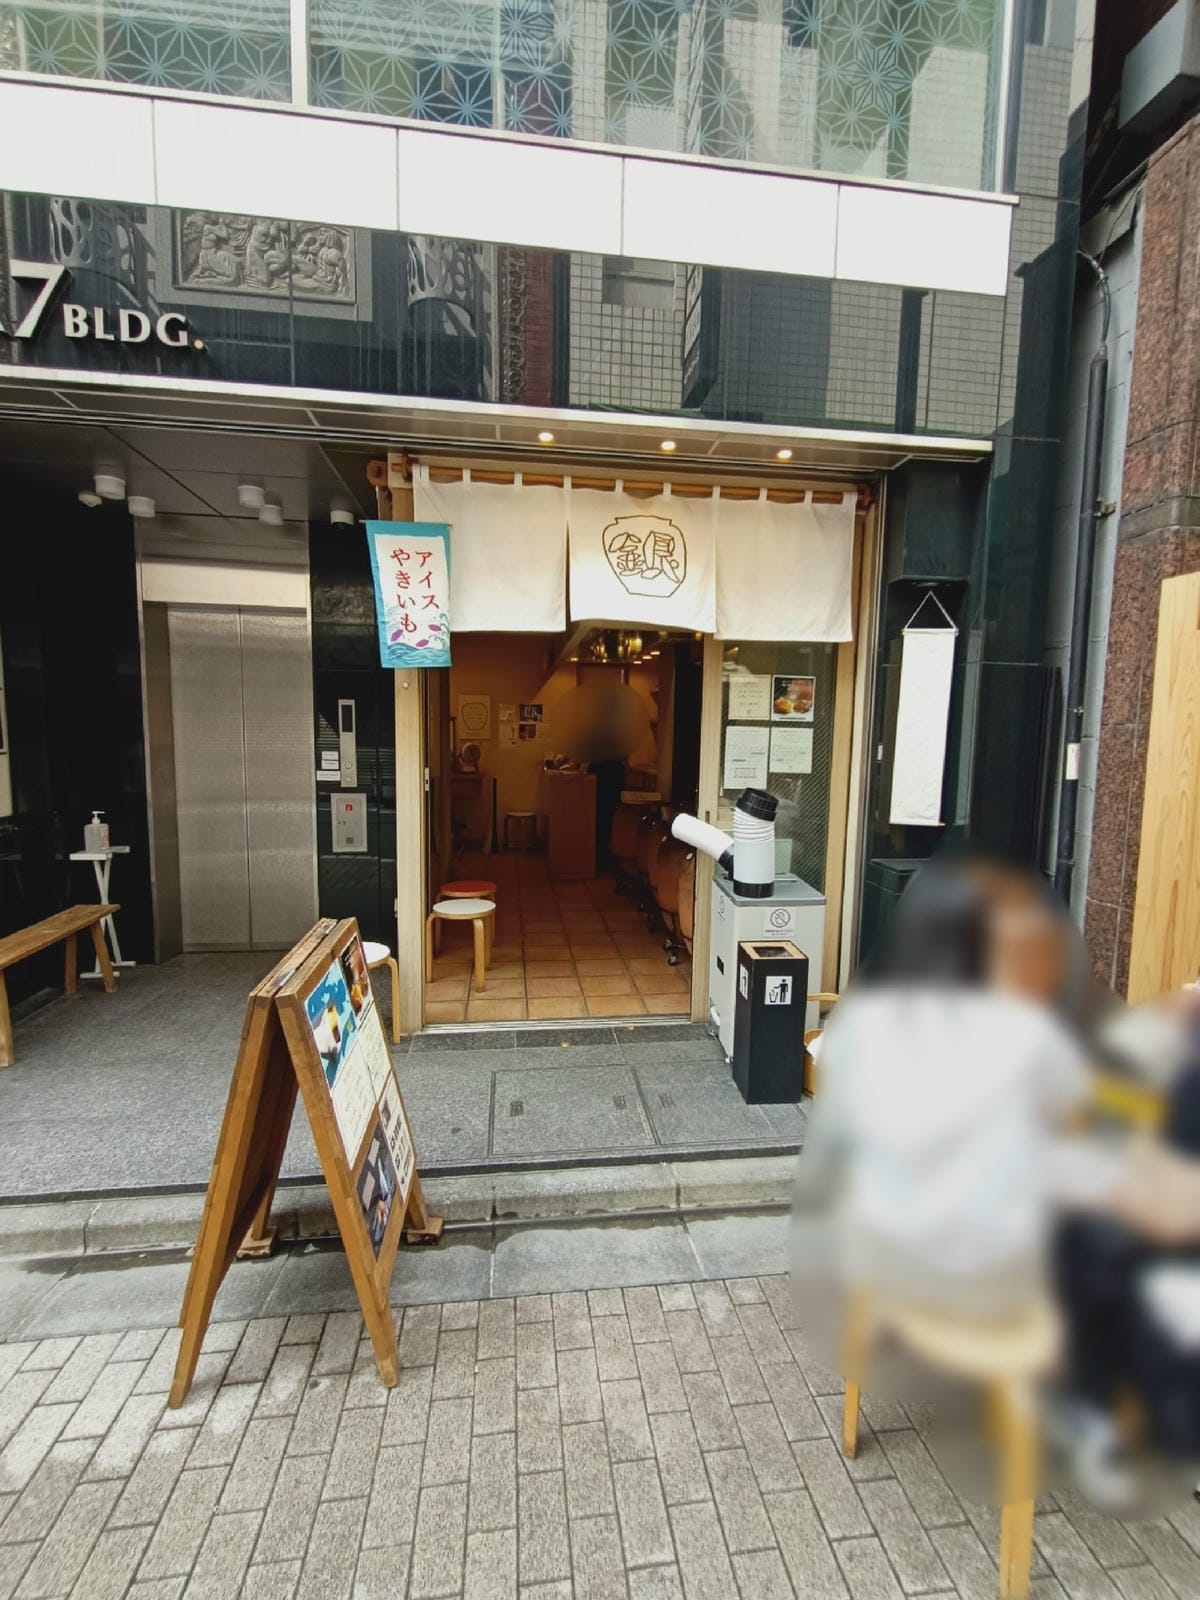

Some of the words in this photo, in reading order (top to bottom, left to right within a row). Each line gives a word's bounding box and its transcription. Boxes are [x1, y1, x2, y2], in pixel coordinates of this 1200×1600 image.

[390, 547, 417, 633] やきいも
[414, 551, 440, 610] アイス
